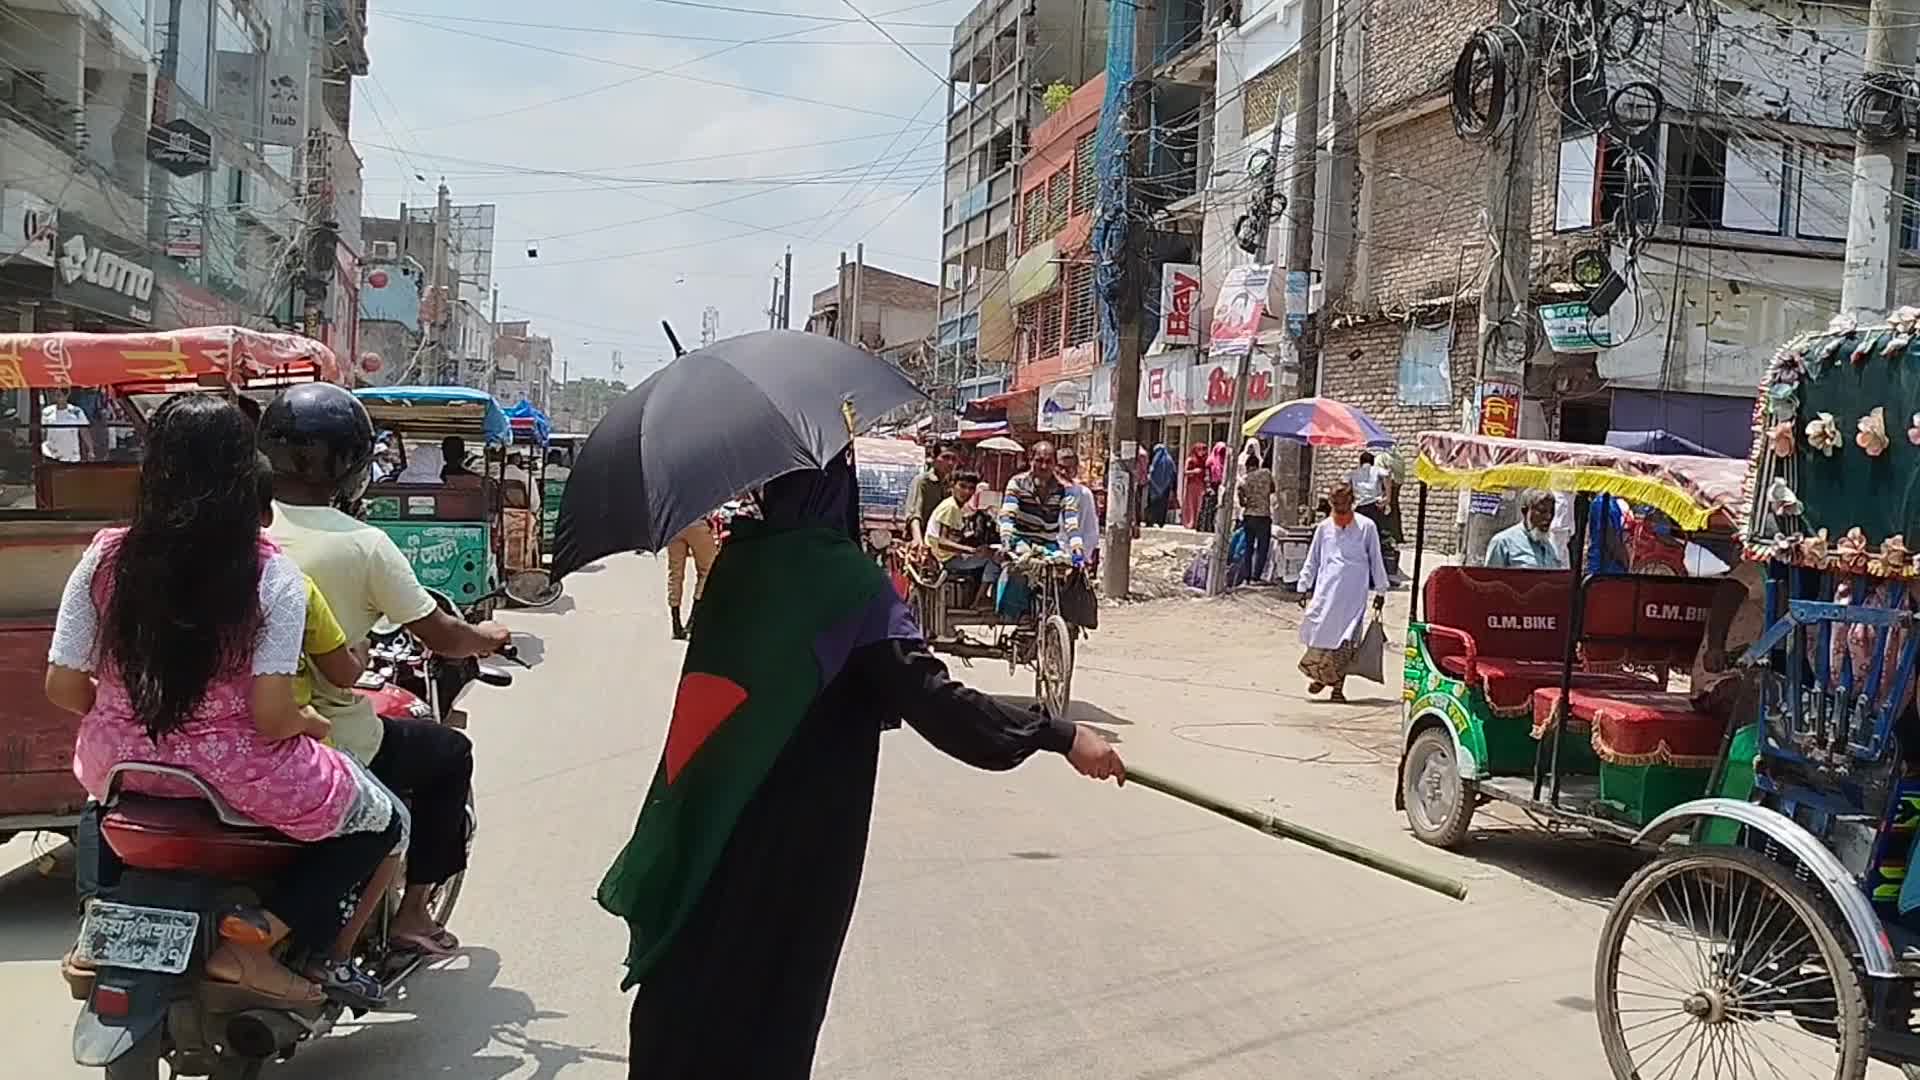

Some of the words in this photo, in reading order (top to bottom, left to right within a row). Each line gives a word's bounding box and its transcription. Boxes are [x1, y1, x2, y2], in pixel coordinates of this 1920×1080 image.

[270, 114, 297, 126] hub
[84, 248, 154, 301] LOTTO
[1166, 272, 1200, 337] Bay
[1645, 603, 1683, 620] G.M.
[1487, 615, 1522, 629] G.M.
[1523, 616, 1557, 630] BIKE
